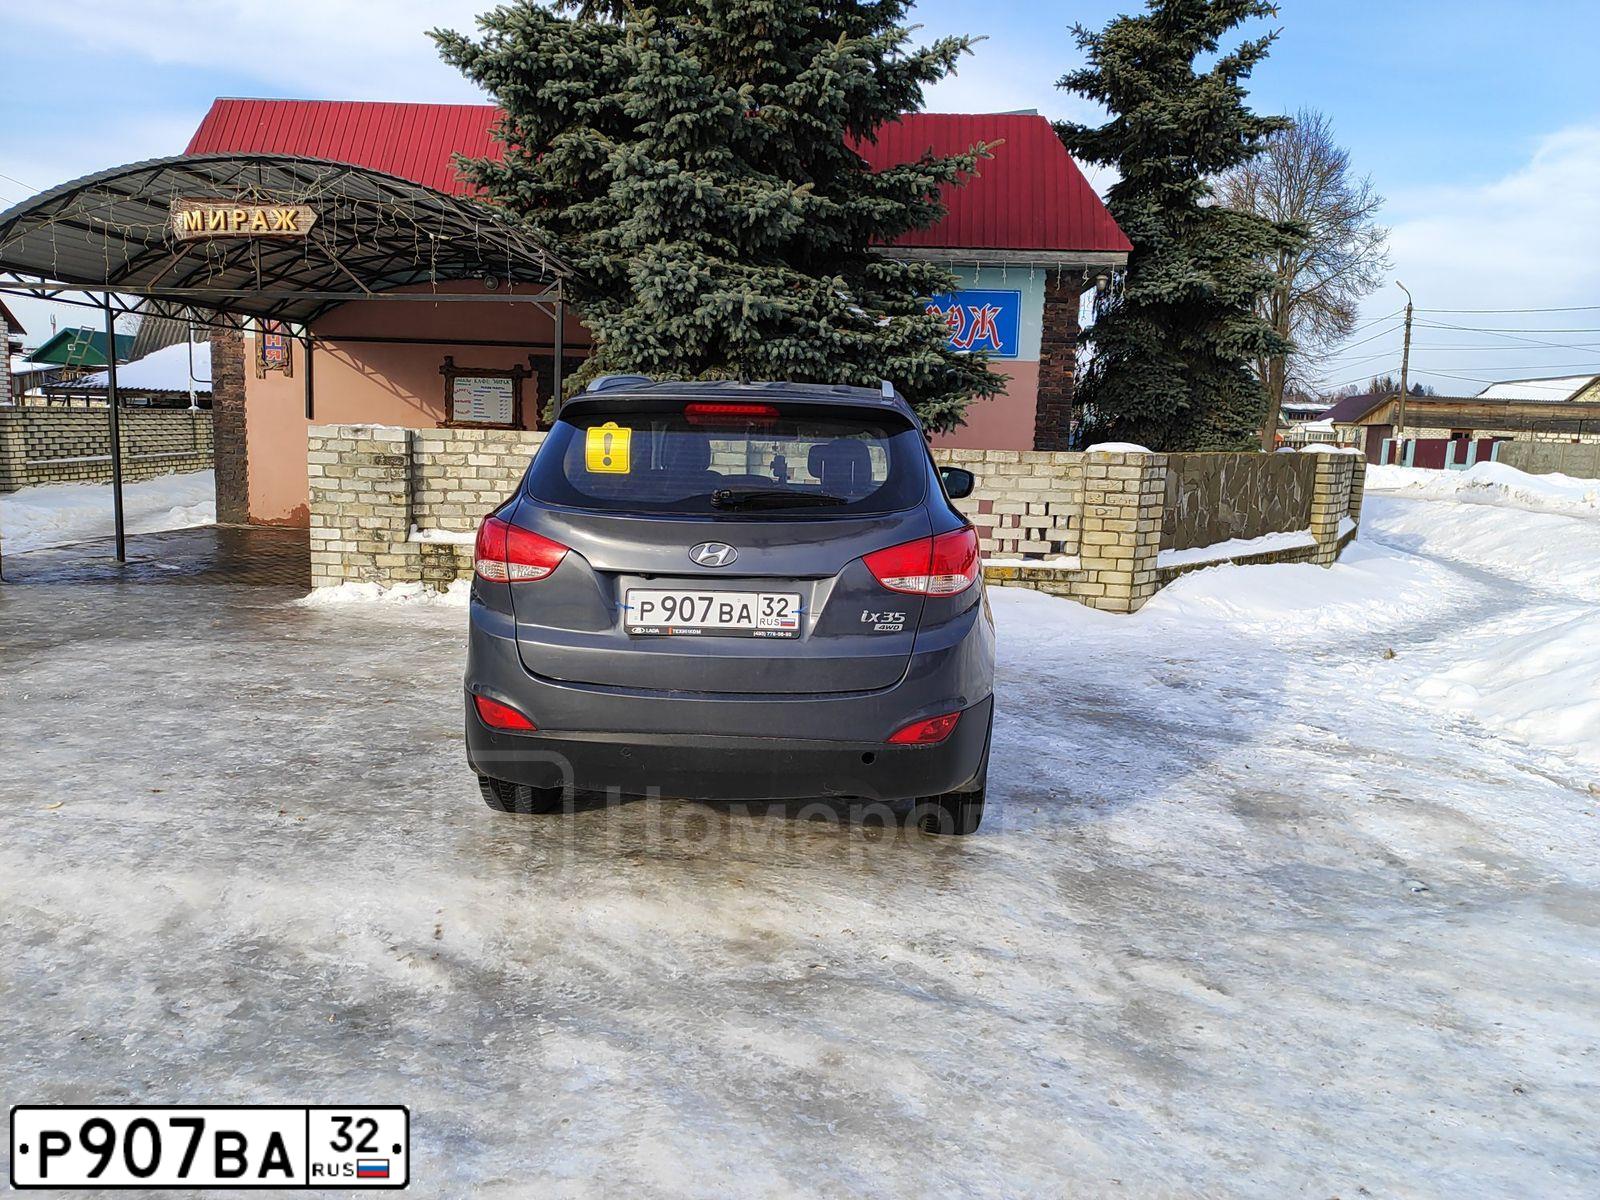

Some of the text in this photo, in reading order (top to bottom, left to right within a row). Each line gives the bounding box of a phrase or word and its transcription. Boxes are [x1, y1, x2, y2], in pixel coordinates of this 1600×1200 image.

[182, 208, 299, 231] МИРАЖ
[925, 303, 1003, 350] АЖ
[639, 595, 790, 625] Р907ВА 32
[860, 609, 907, 623] ix35
[759, 617, 780, 627] RUS
[878, 623, 901, 631] 4WD
